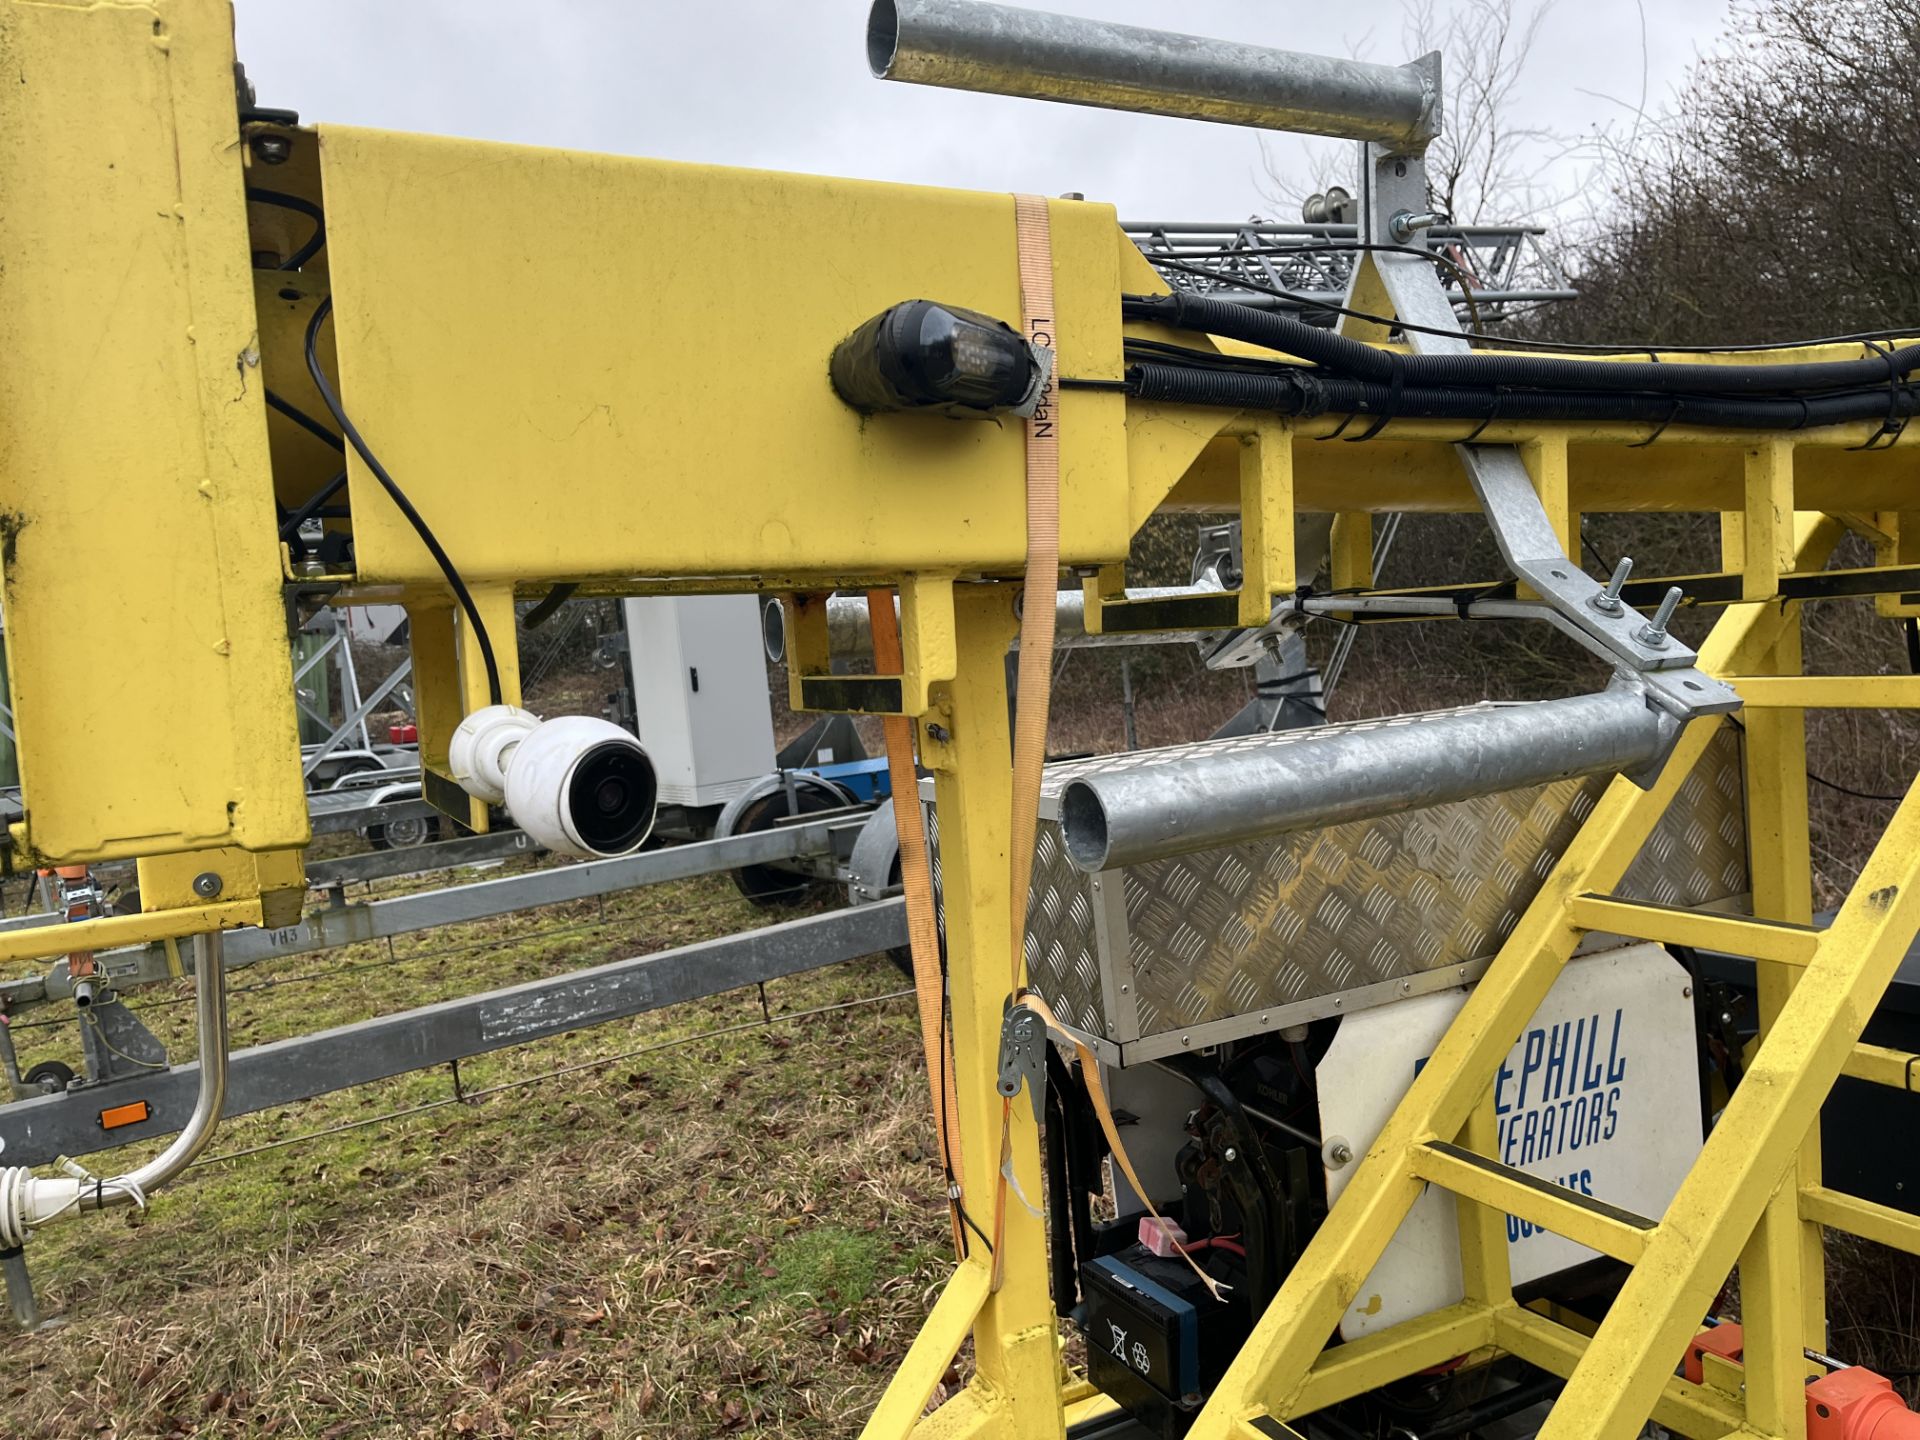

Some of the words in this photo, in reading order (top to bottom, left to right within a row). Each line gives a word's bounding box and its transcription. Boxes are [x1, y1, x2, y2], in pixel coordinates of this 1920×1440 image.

[269, 928, 299, 947] VH3
[1495, 1008, 1627, 1116] EPHILL
[1498, 1086, 1621, 1168] ERATORS
